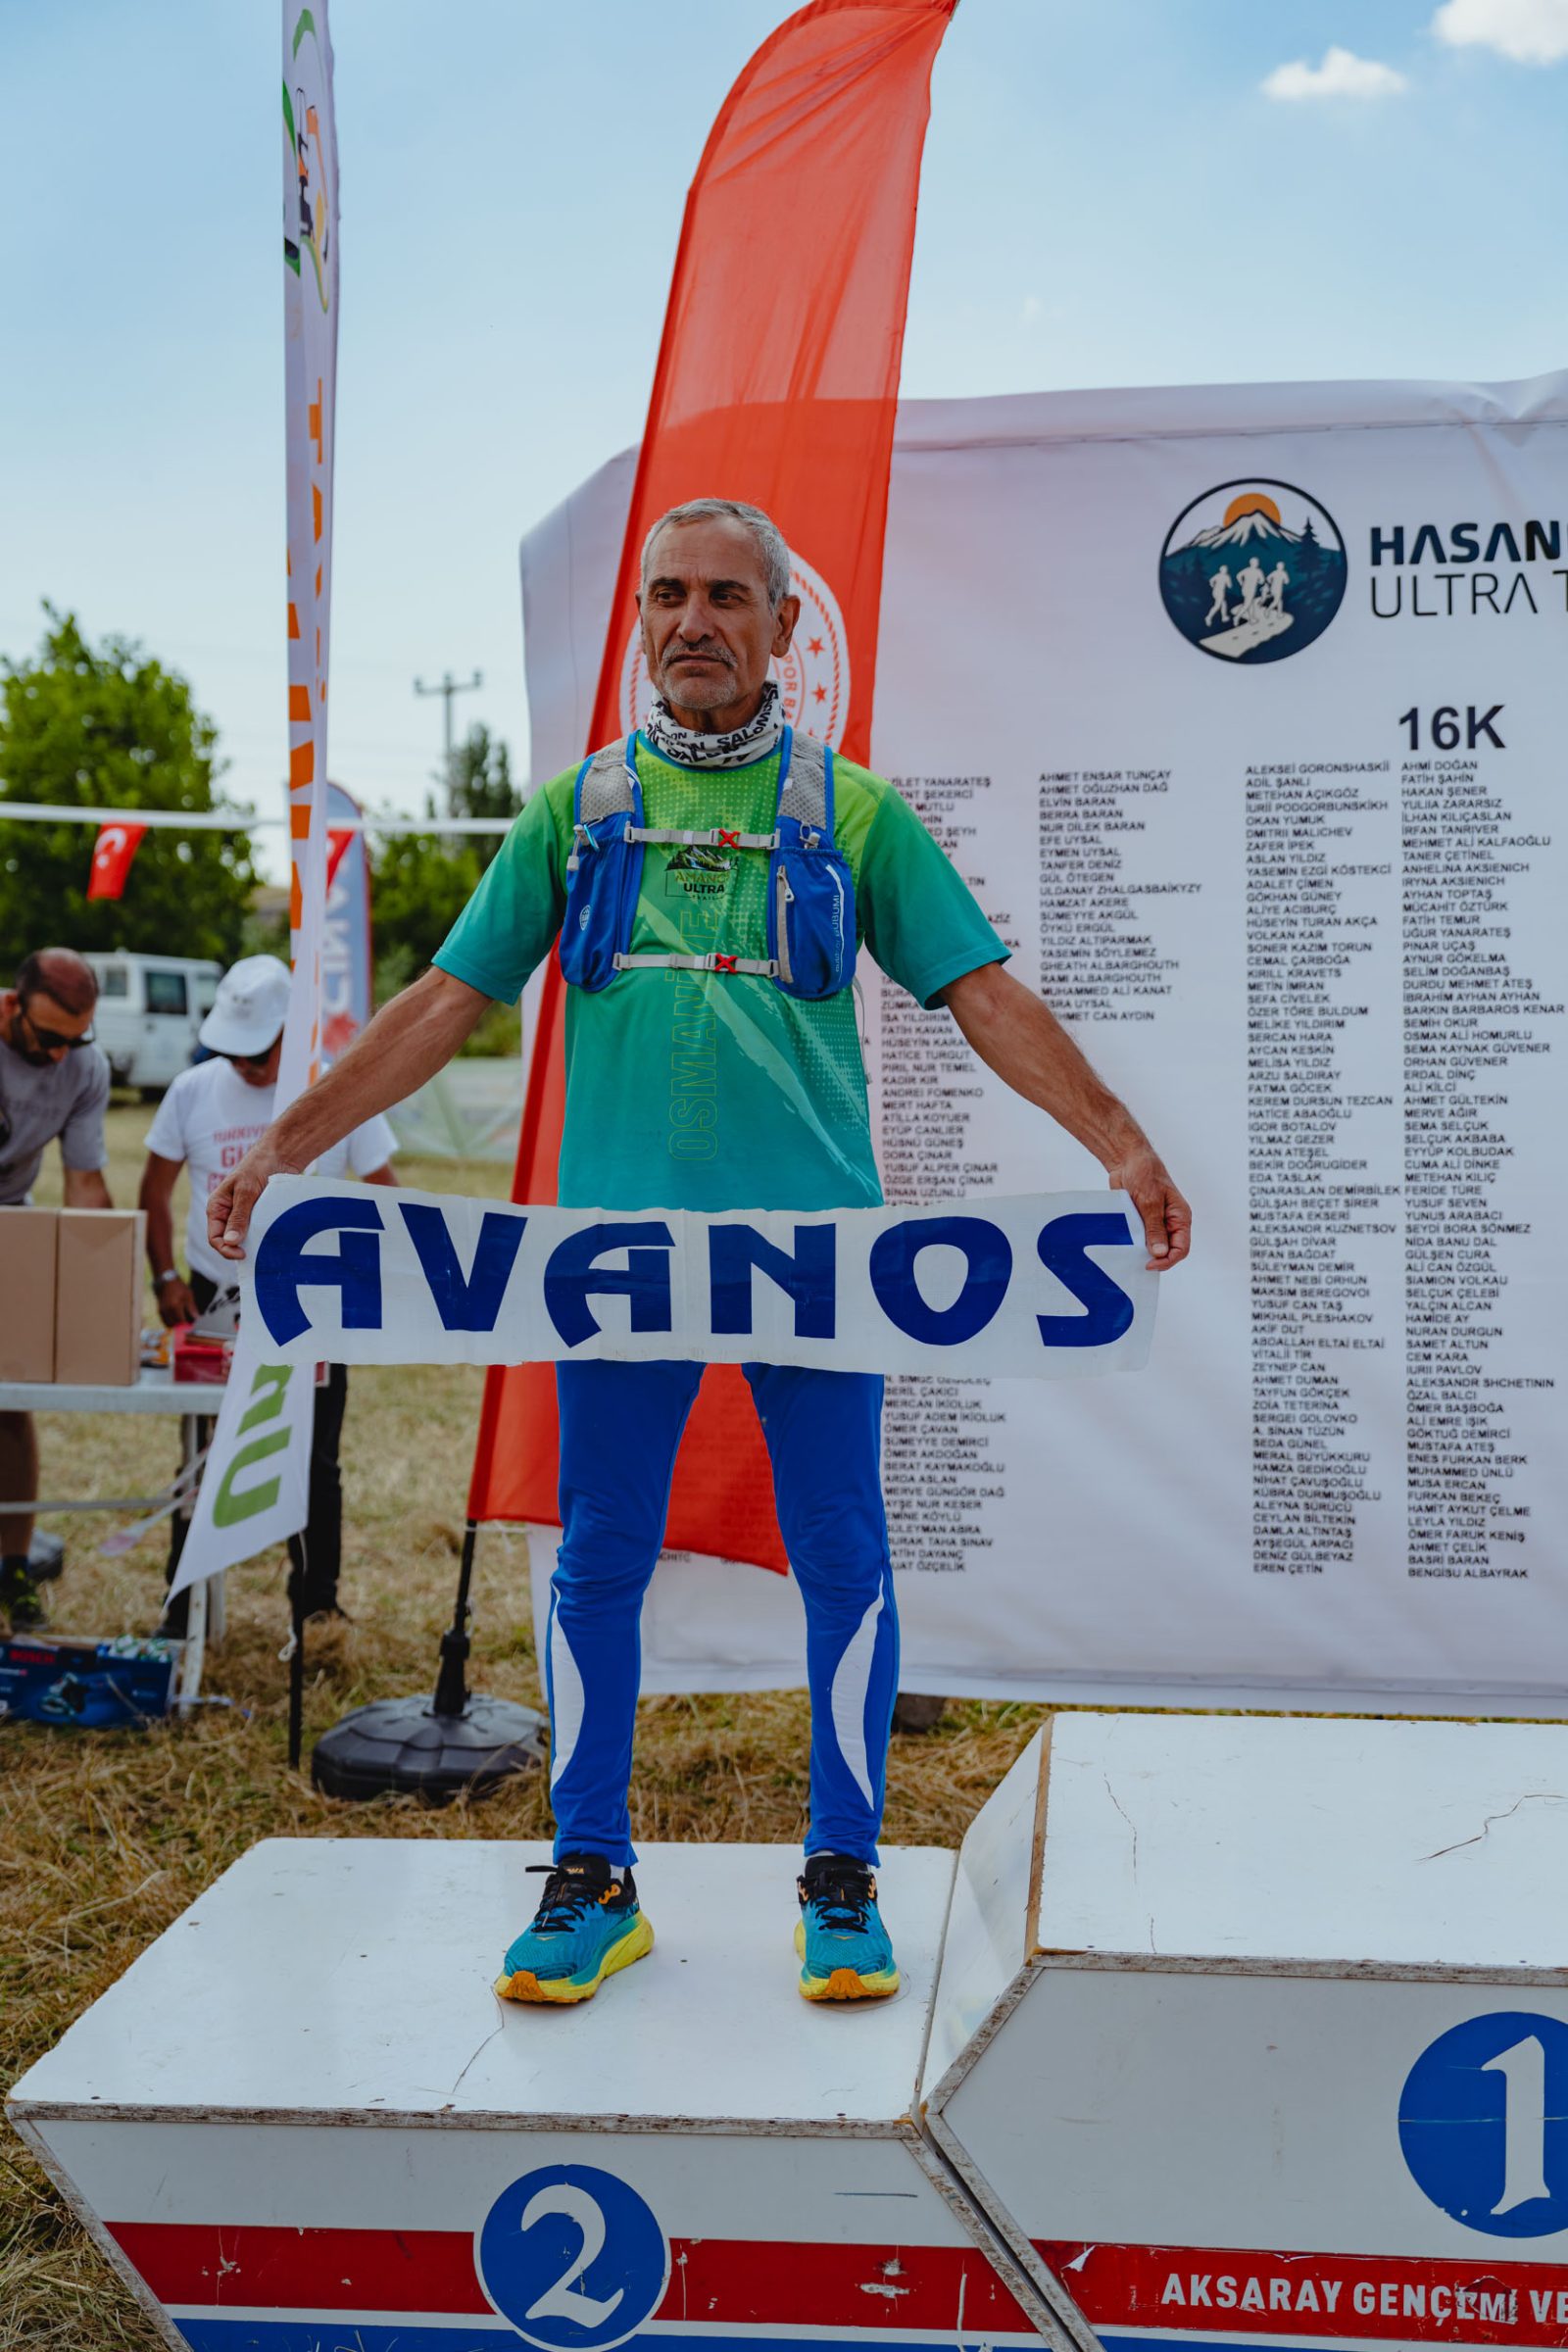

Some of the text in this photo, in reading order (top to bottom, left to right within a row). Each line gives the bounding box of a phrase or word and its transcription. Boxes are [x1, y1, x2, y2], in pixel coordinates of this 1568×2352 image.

[1370, 520, 1568, 565] HASAN
[1370, 572, 1538, 618] ULTRA
[1398, 705, 1506, 751] 16K
[683, 883, 725, 895] ULTRA
[254, 1195, 1135, 1348] AVANOS
[1481, 2034, 1551, 2215] 1
[519, 2181, 624, 2329] 2
[1160, 2273, 1344, 2313] AKSARAY
